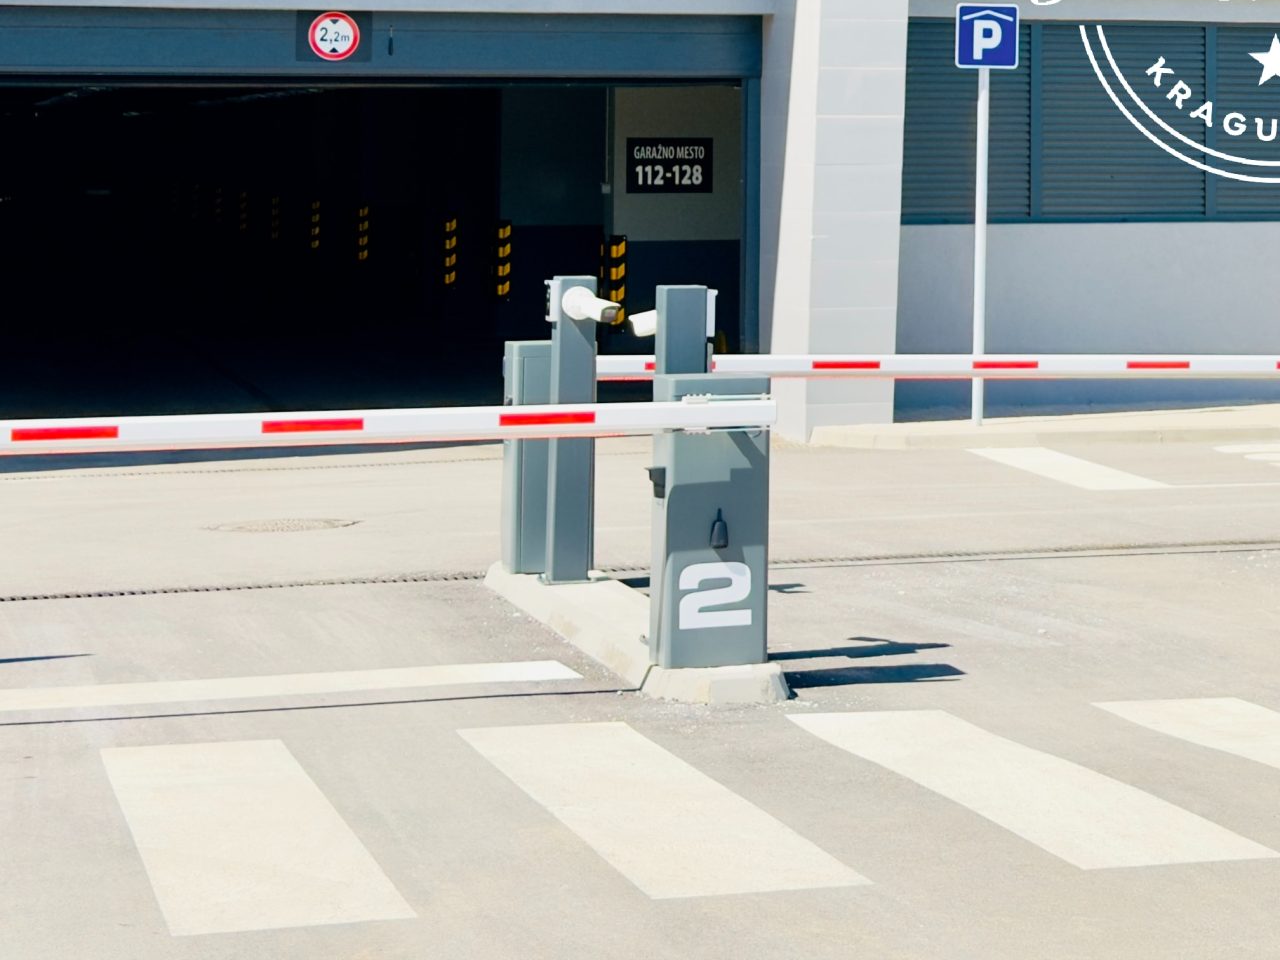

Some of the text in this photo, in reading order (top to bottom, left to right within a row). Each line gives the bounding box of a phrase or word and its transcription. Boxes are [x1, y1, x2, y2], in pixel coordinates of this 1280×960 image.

[973, 19, 1003, 60] P
[633, 143, 705, 160] GARAŽNO MESTO
[635, 164, 703, 186] 112-128
[678, 561, 752, 631] 2
